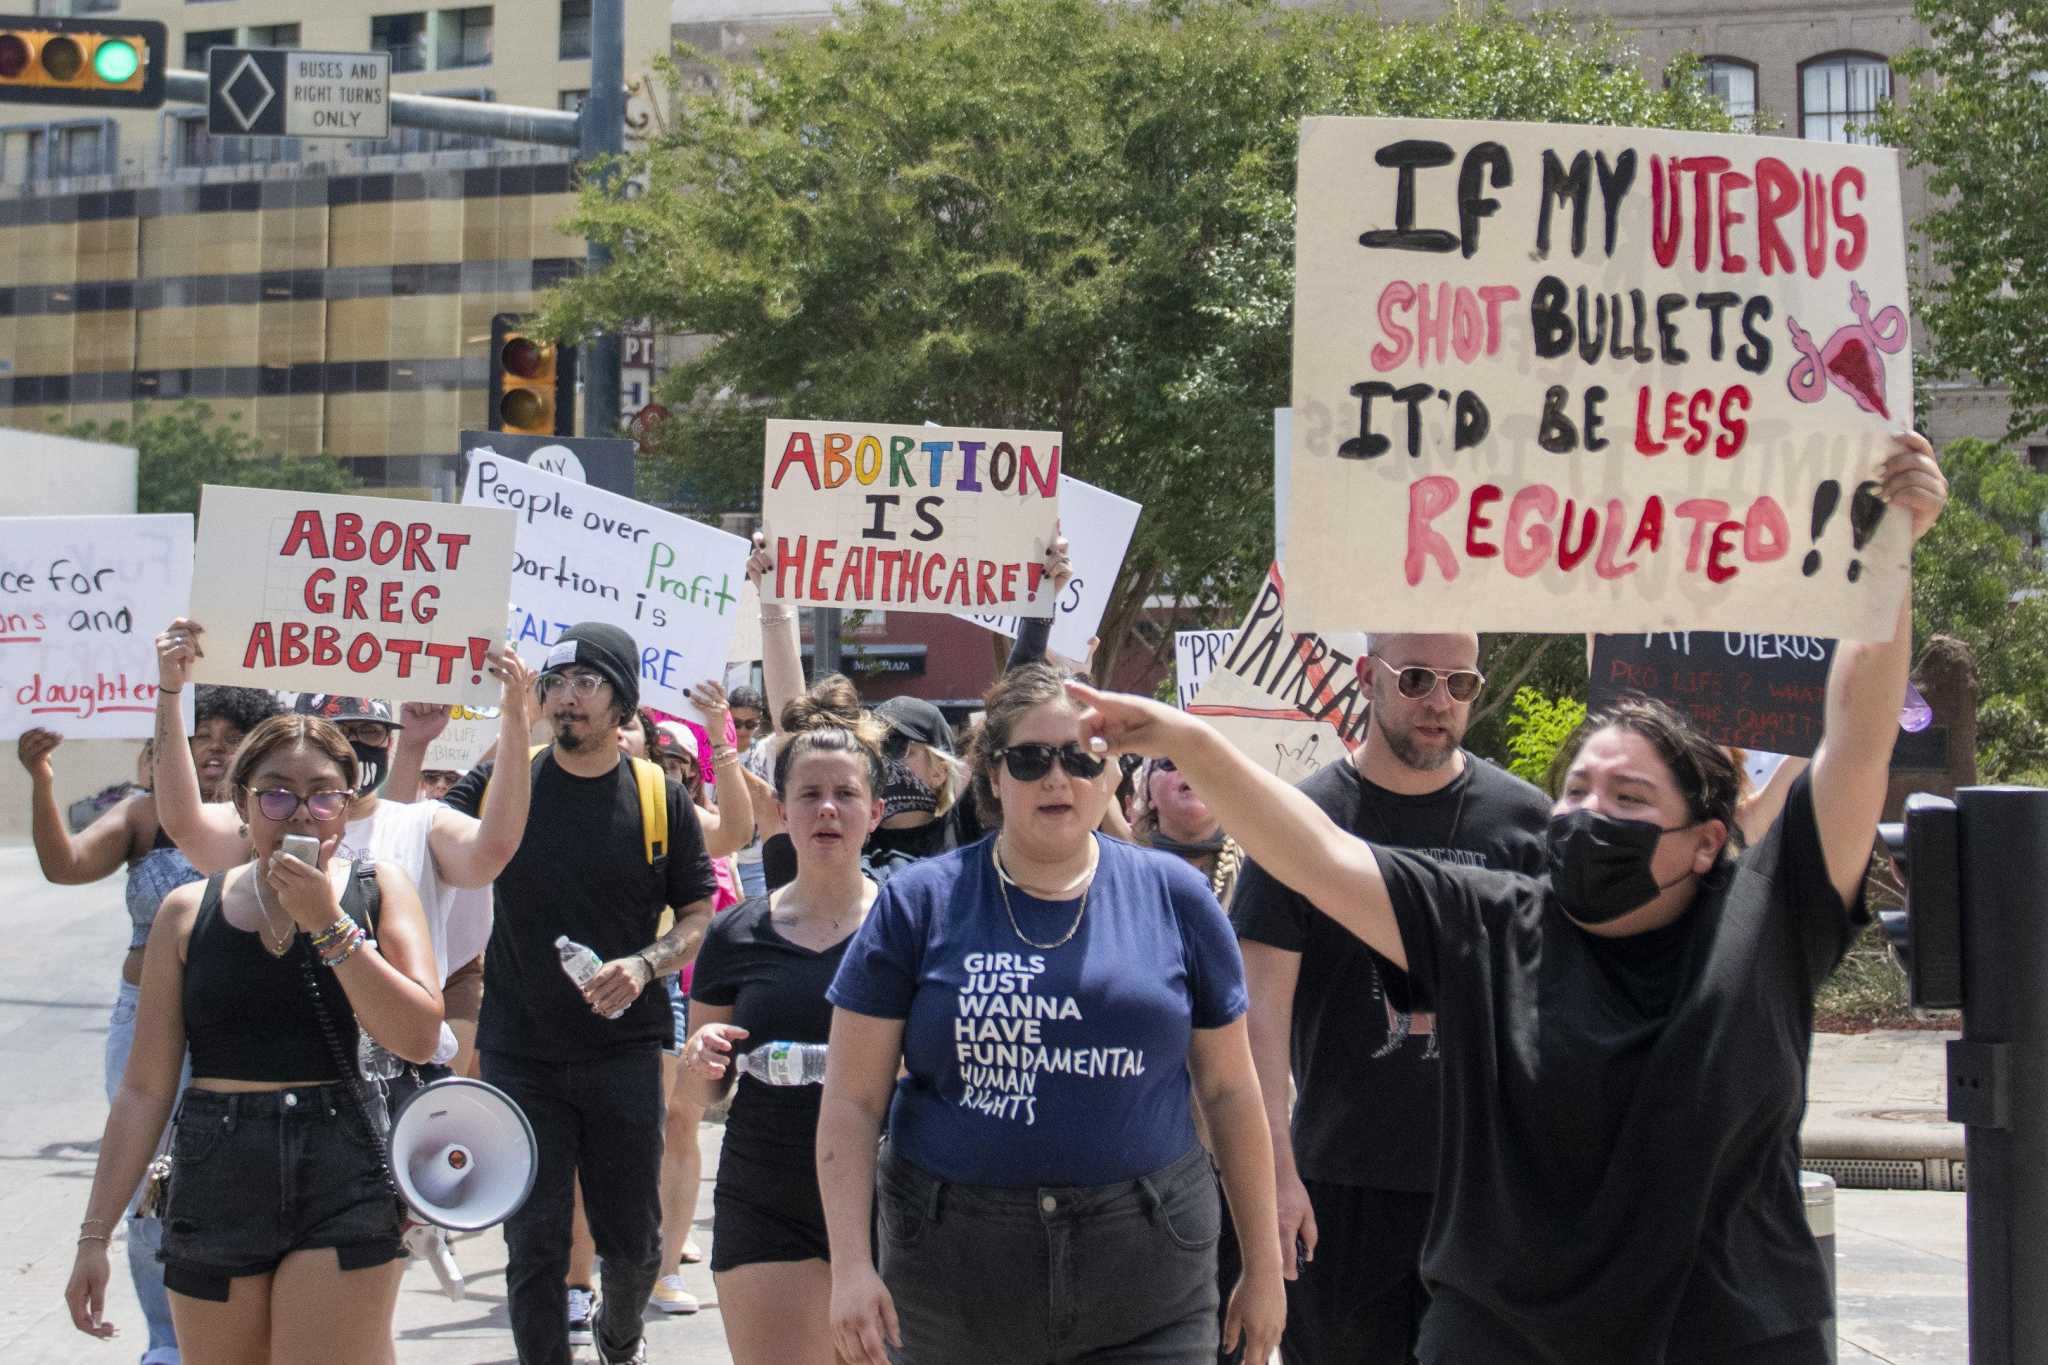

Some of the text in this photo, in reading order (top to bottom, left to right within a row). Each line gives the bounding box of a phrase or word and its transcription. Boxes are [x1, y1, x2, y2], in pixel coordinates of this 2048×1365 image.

[300, 61, 377, 80] BUSES AND
[294, 86, 382, 104] RIGHT TURNS
[313, 110, 361, 127] ONLY
[1358, 139, 1868, 280] IF MY UTERUS
[1370, 275, 1774, 375] SHOT BULLETS
[1337, 381, 1491, 460] IT'D
[1537, 385, 1610, 454] BE
[1634, 384, 1753, 460] LESS
[771, 431, 1060, 498] ABORTION
[862, 494, 945, 541] IS
[280, 510, 471, 572] ABORT
[478, 461, 737, 615] People over Profit
[48, 559, 116, 594] for
[304, 567, 441, 624] GREG
[634, 592, 667, 628] is
[68, 605, 133, 634] and
[242, 622, 491, 685] ABBOTT!
[1672, 671, 1722, 693] LIFE
[964, 952, 1045, 974] GIRLS
[960, 973, 1034, 994] JUST
[958, 995, 1082, 1020] WANNA
[955, 1017, 1041, 1044] HAVE
[956, 1043, 1145, 1078] FUNDAMENTAL
[960, 1064, 1036, 1095] HUMAN
[960, 1085, 1036, 1126] RIGHTS
